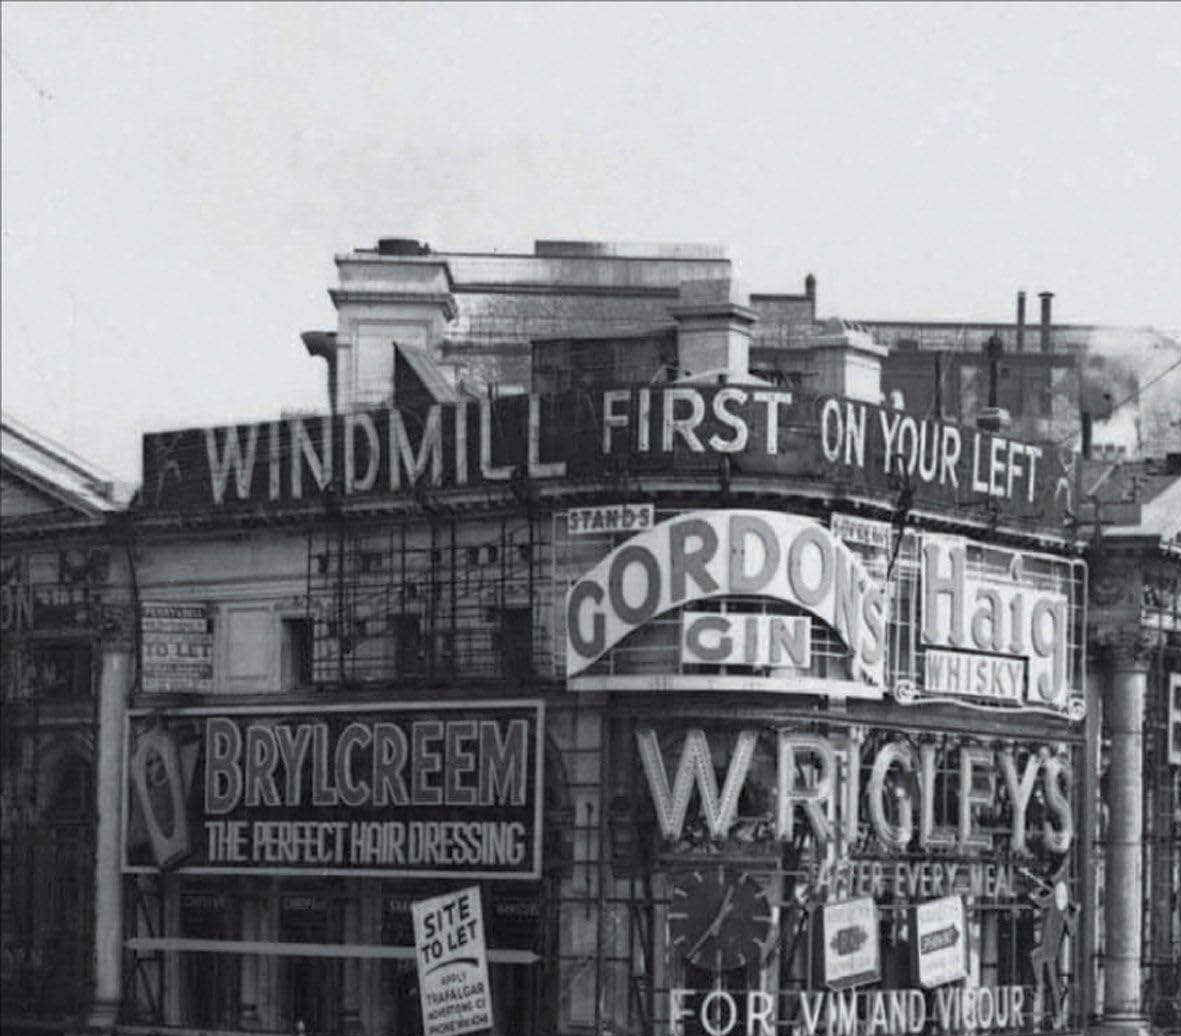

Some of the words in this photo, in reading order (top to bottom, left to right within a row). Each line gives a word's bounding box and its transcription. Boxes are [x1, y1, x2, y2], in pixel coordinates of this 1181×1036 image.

[207, 394, 567, 503] WINDMILL
[603, 387, 793, 455] FIRST
[821, 399, 867, 467] ON
[879, 409, 962, 488] YOUR
[972, 432, 1043, 503] LEFT
[568, 509, 650, 530] STANDS
[684, 616, 810, 668] GIN
[921, 541, 1068, 702] Haig
[145, 641, 167, 657] TO
[176, 642, 213, 658] LET
[926, 656, 1025, 703] WHISKY
[204, 716, 529, 815] BRYLCREEM
[204, 820, 249, 862] THE
[252, 820, 348, 865] PERFECT
[350, 821, 405, 865] HAIR
[408, 822, 527, 867] DRESSING
[816, 860, 884, 898] AFTER
[894, 861, 959, 898] EVERY
[971, 864, 1017, 898] MEAL
[424, 895, 470, 939] SITE
[421, 940, 443, 965] TO
[447, 919, 478, 953] LET
[425, 982, 485, 1006] TRAFALGAR
[870, 990, 927, 1034] AND
[938, 985, 1025, 1031] VIGOUR
